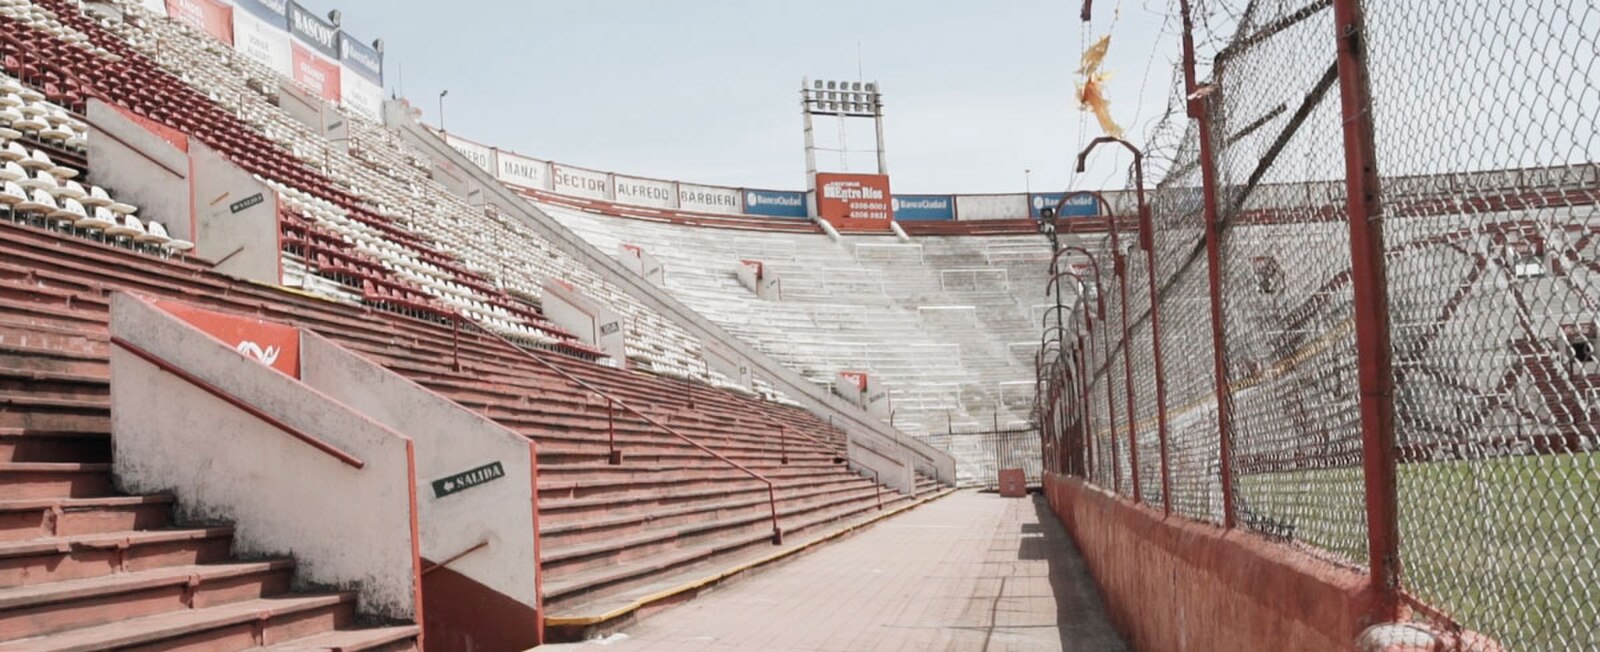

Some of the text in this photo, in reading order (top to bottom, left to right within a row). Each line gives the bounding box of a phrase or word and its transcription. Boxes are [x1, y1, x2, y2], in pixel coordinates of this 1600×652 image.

[293, 9, 333, 48] BASCOY
[555, 166, 605, 192] SECTOR
[618, 183, 669, 201] ALFREDO
[681, 191, 736, 207] BARBIERI
[757, 195, 801, 206] BancoCiudad
[901, 200, 946, 209] BancoCiudad
[456, 465, 501, 488] SALIDA
